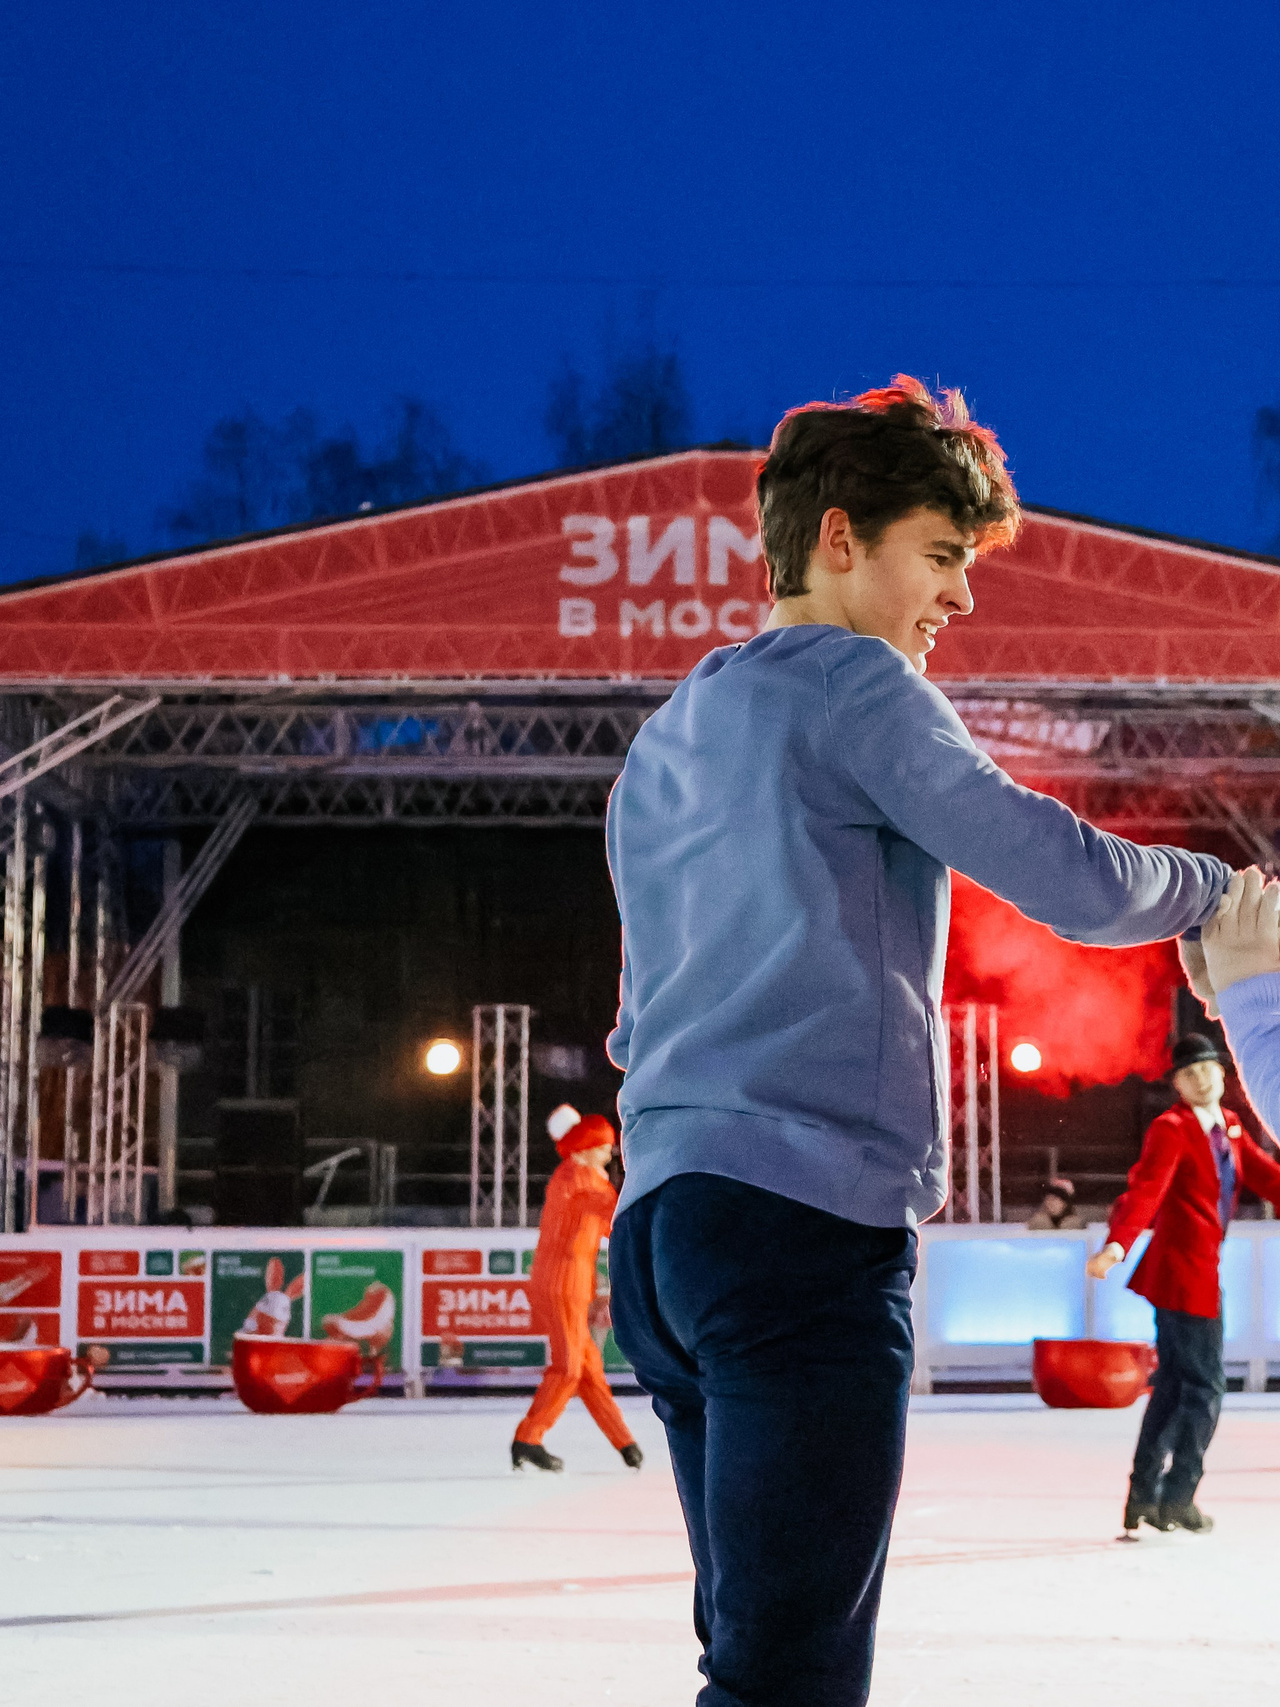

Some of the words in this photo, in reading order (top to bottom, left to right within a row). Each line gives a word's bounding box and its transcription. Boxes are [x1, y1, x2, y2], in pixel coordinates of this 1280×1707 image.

[559, 513, 763, 585] ЗИМ
[558, 597, 597, 637] В
[94, 1289, 188, 1313] ЗИМА
[438, 1288, 532, 1312] ЗИМА
